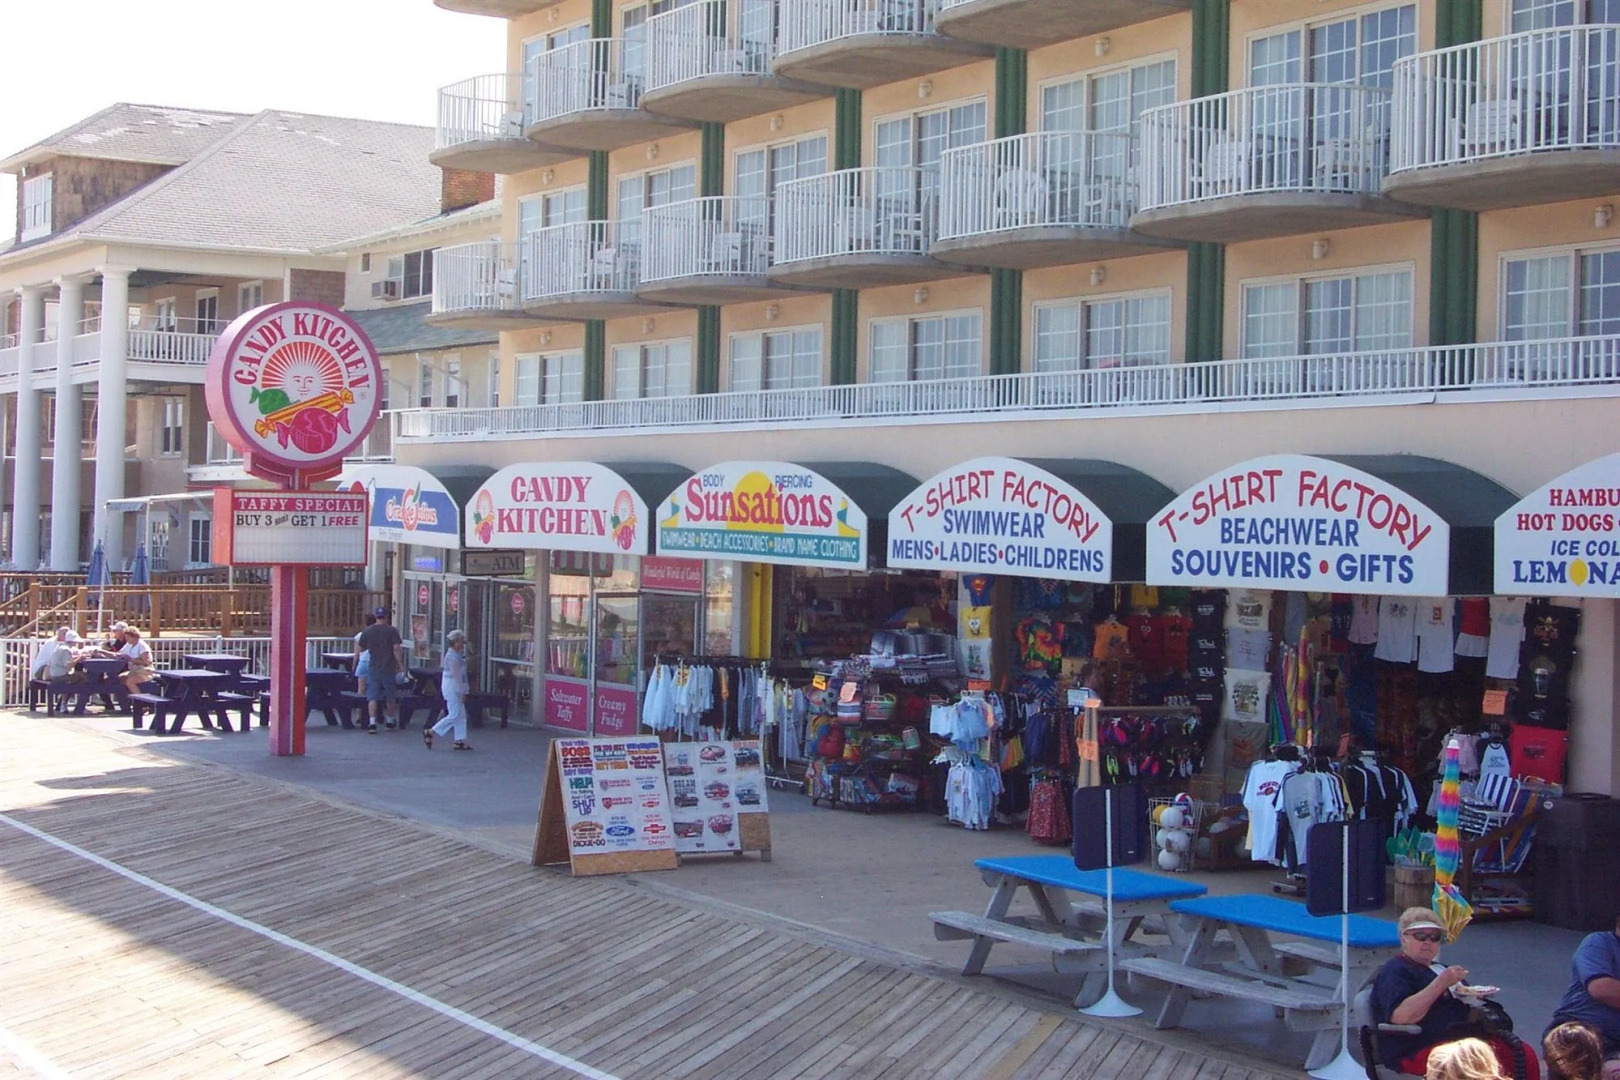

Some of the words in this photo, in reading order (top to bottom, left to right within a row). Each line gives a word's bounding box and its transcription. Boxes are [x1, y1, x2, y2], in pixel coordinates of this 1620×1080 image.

[234, 316, 288, 386] CANDY
[294, 312, 370, 389] KITCHEN
[510, 475, 592, 503] CANDY
[703, 474, 725, 487] BODY
[775, 474, 812, 488] PIERCING
[239, 498, 288, 511] TAFFY
[295, 499, 361, 512] SPECIAL
[685, 477, 833, 528] Sunsations
[900, 470, 994, 532] T-SHIRT
[1002, 470, 1099, 543] FACTORY
[1158, 470, 1283, 543] T-SHIRT
[1298, 470, 1432, 551] FACTORY
[236, 513, 262, 526] BUY
[265, 514, 272, 526] 3
[291, 514, 317, 527] GET
[321, 515, 328, 526] 1
[328, 515, 359, 527] FREE
[497, 506, 608, 537] KITCHEN
[943, 508, 1045, 539] SWIMWEAR
[1517, 513, 1556, 531] HOT
[1562, 513, 1614, 532] DOGS
[1220, 517, 1359, 547] BEACHWEAR
[662, 529, 695, 546] SWIMWEAR
[700, 531, 722, 548] BEACH
[723, 532, 769, 552] ACCESSORIES
[774, 537, 795, 554] BRAND
[797, 539, 818, 556] NAME
[820, 540, 857, 559] CLOTHING
[1551, 540, 1580, 556] ICE
[492, 556, 520, 571] ATM
[892, 539, 933, 560] MENS
[939, 542, 997, 564] LADIES
[1005, 544, 1104, 573] CHILDRENS
[1171, 549, 1311, 579] SOUVENIRS
[1336, 553, 1414, 584] GIFTS
[550, 688, 582, 705] Saltwater
[598, 695, 626, 714] Creamy
[557, 704, 573, 722] Taffy
[600, 712, 623, 730] Fudge
[572, 799, 595, 809] SHUT
[579, 806, 592, 816] UP
